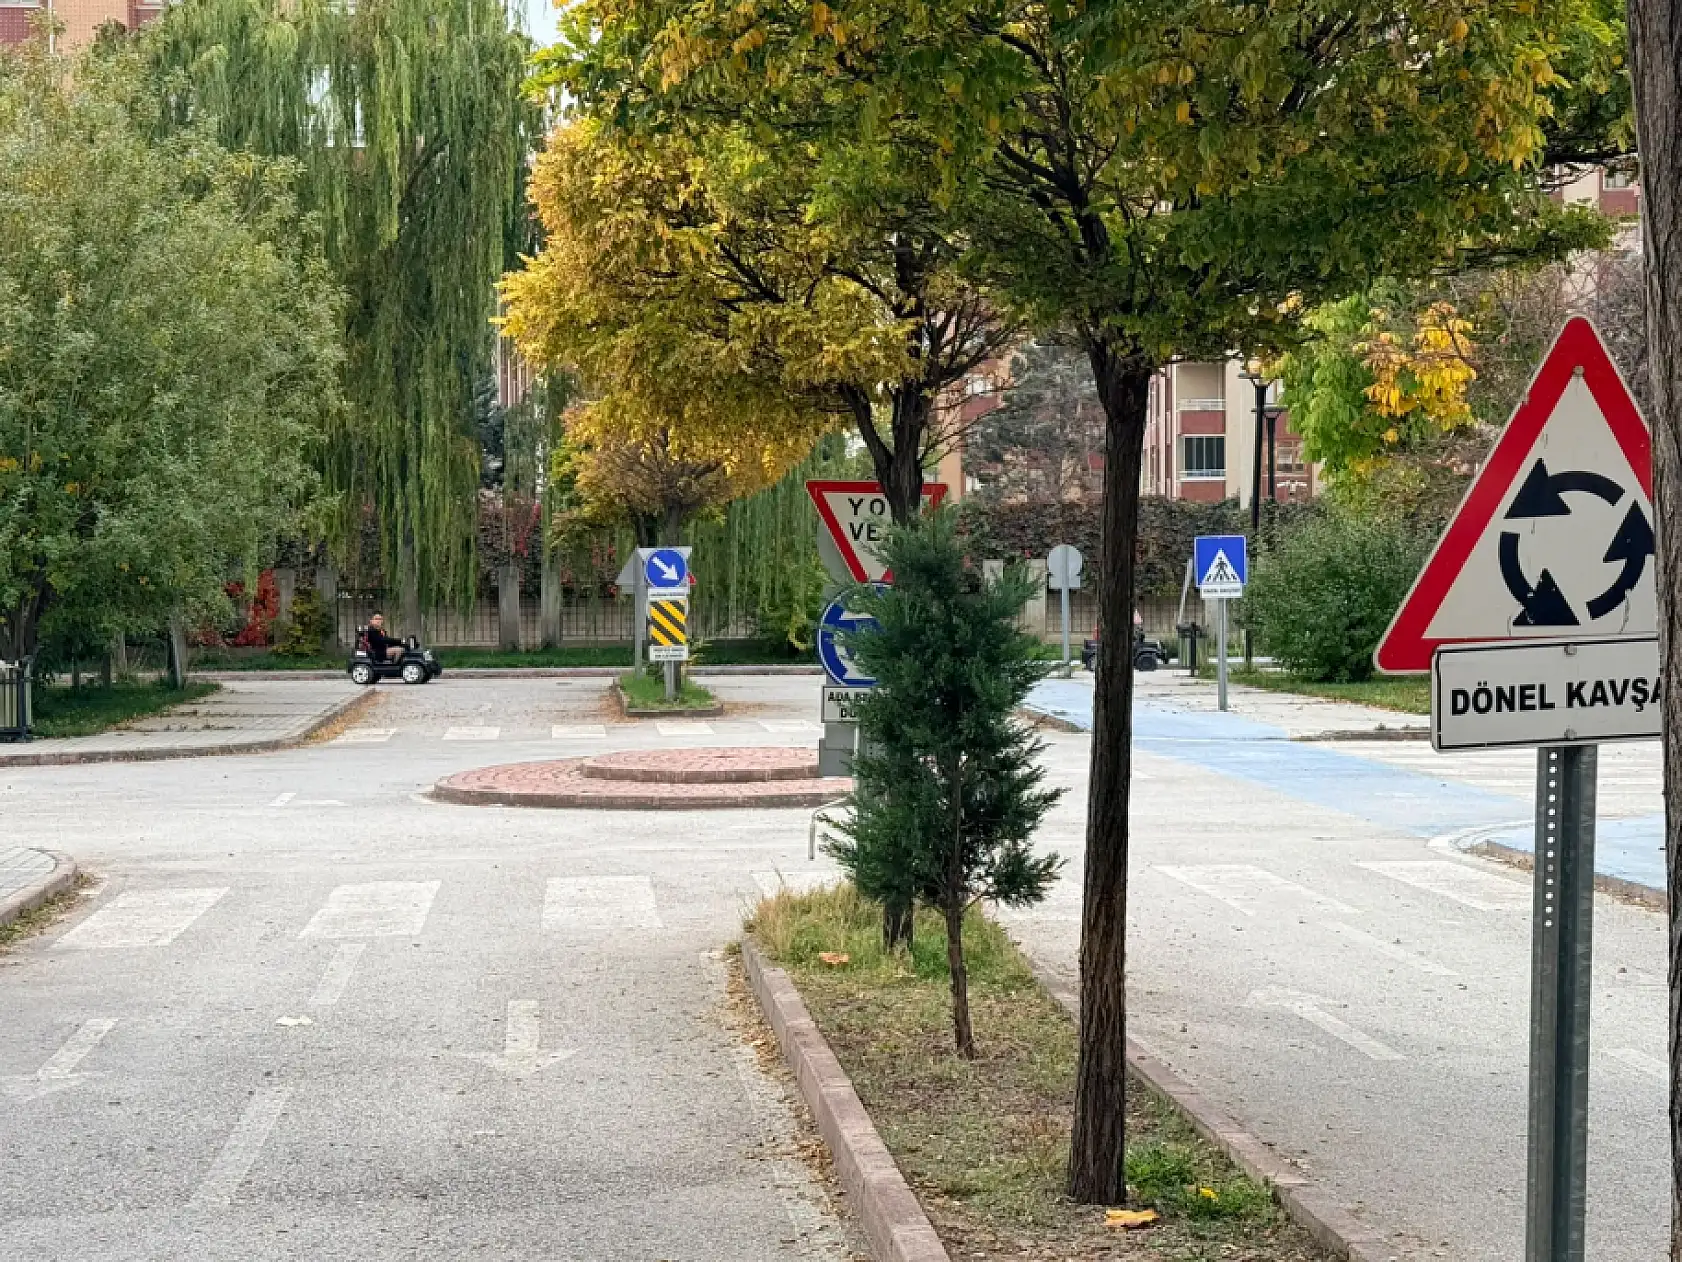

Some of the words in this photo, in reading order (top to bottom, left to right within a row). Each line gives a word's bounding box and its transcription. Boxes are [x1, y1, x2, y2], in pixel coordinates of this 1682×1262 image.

[848, 498, 886, 516] YO
[849, 522, 881, 541] VE
[1451, 681, 1556, 716] DÖNEL
[1566, 676, 1661, 712] KAVŞA
